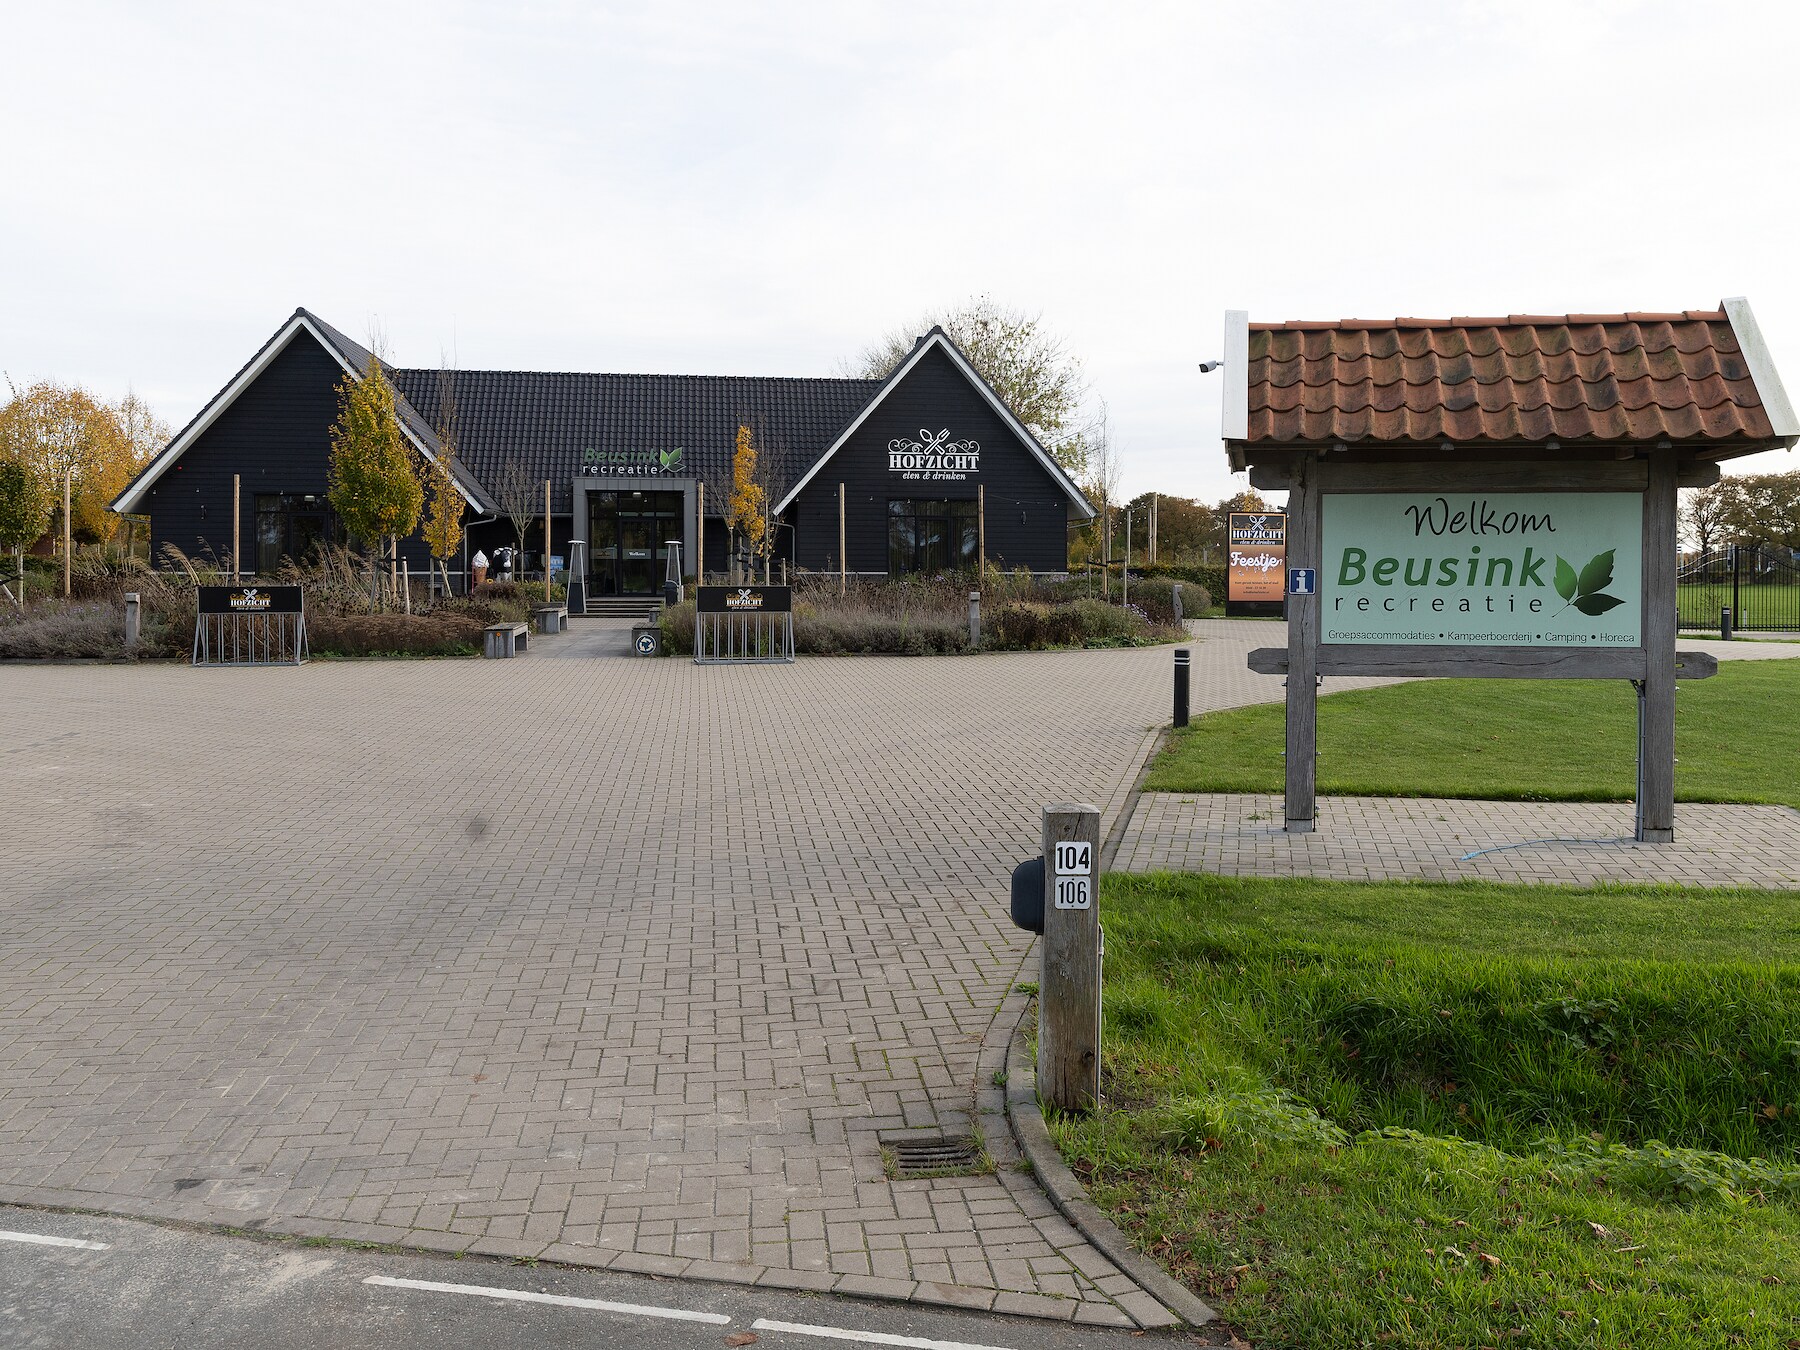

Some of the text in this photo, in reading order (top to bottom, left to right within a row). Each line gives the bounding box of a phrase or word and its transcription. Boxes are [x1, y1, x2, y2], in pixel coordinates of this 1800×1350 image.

[584, 447, 659, 463] Beusink
[888, 454, 980, 470] HOFZICHT
[582, 465, 658, 474] recreatie
[902, 471, 966, 480] eten & drinken
[1404, 498, 1557, 536] Welkom
[1232, 530, 1283, 539] HOFZICHT
[1337, 545, 1546, 587] Beusink
[1296, 570, 1308, 593] i
[1335, 594, 1543, 613] recreatie
[1328, 629, 1635, 643] Groepsaccommodaties Kampeerboerderij Camping Horeca
[1056, 846, 1090, 870] 104
[1058, 881, 1087, 904] 106
